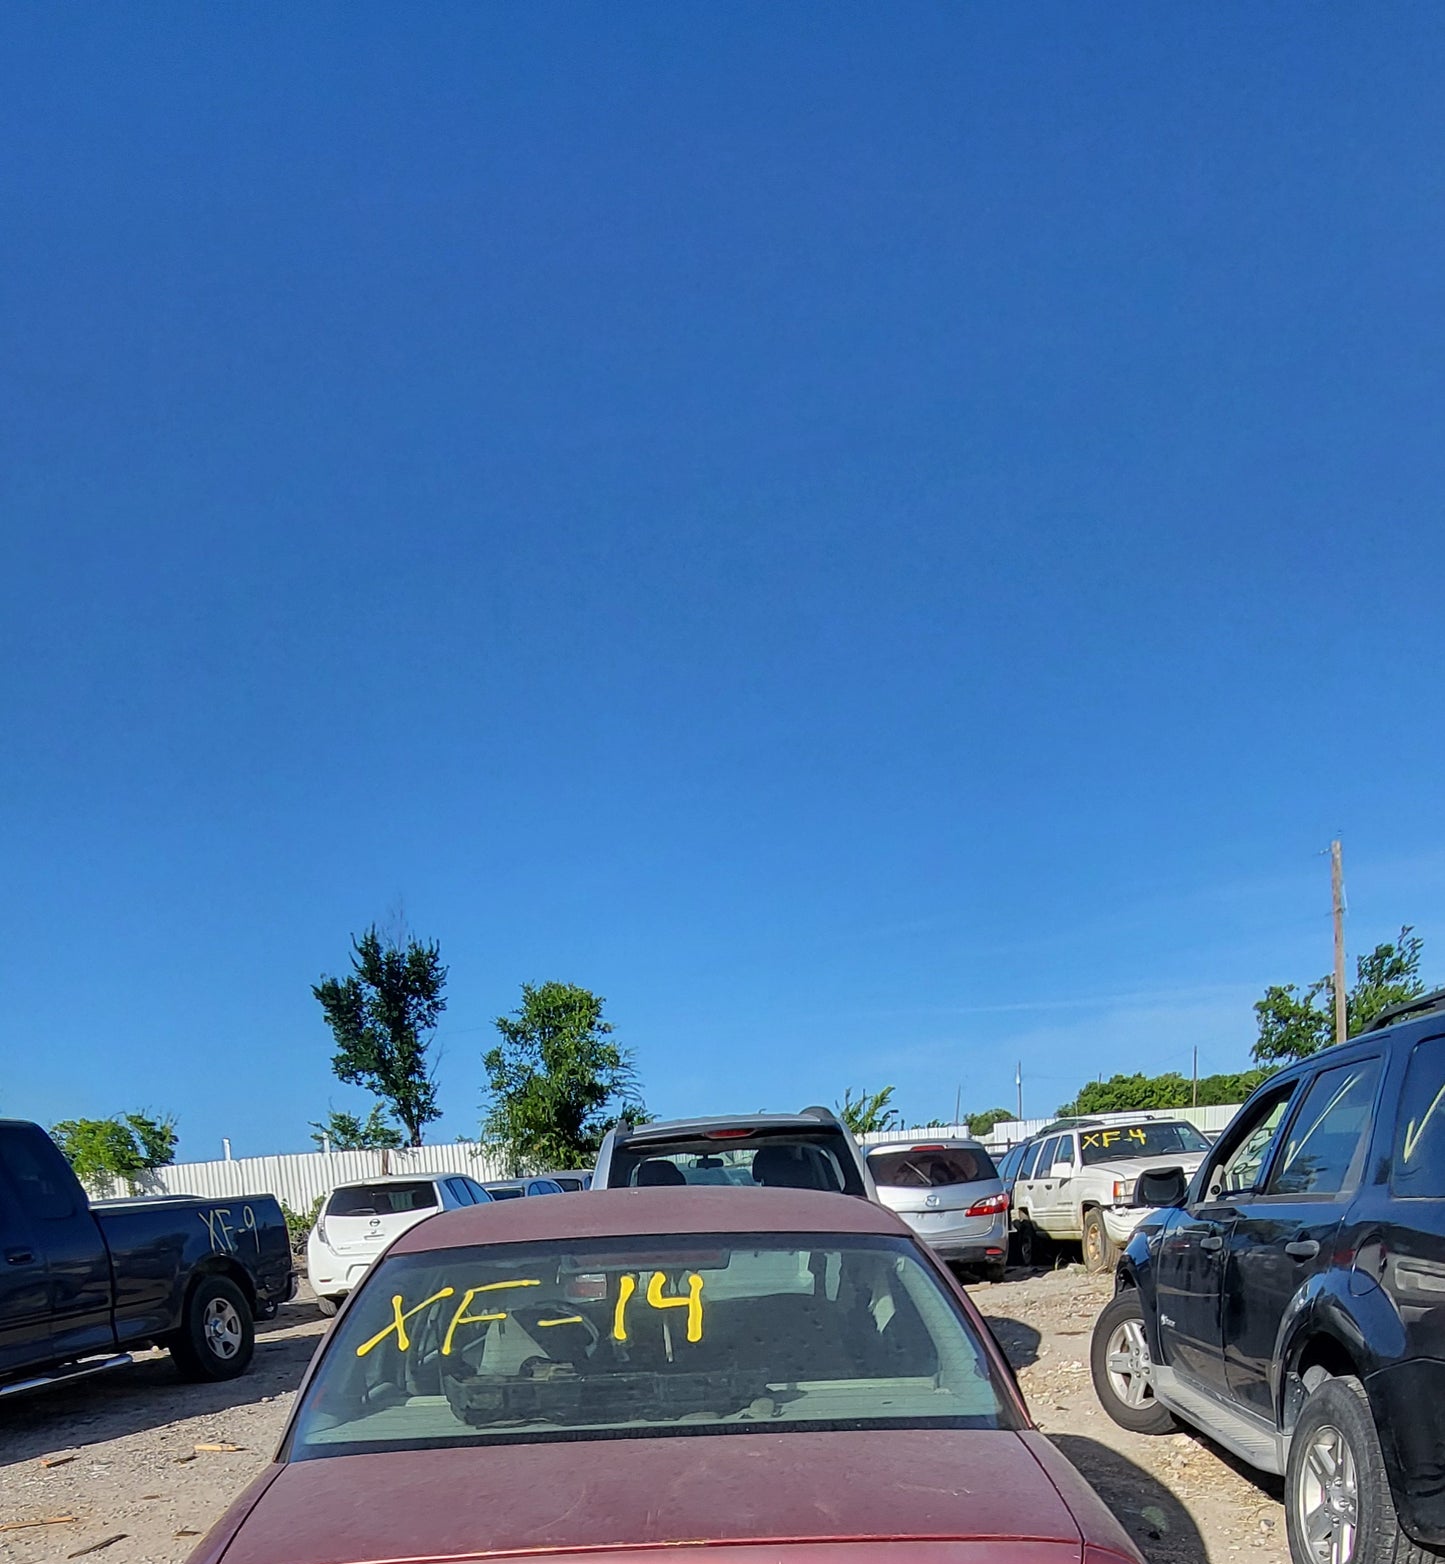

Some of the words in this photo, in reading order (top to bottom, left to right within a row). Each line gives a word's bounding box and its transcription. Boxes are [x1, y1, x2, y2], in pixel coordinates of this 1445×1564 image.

[1081, 1128, 1146, 1150] XF-4
[197, 1205, 260, 1254] XF-9
[356, 1270, 704, 1356] XF-14
